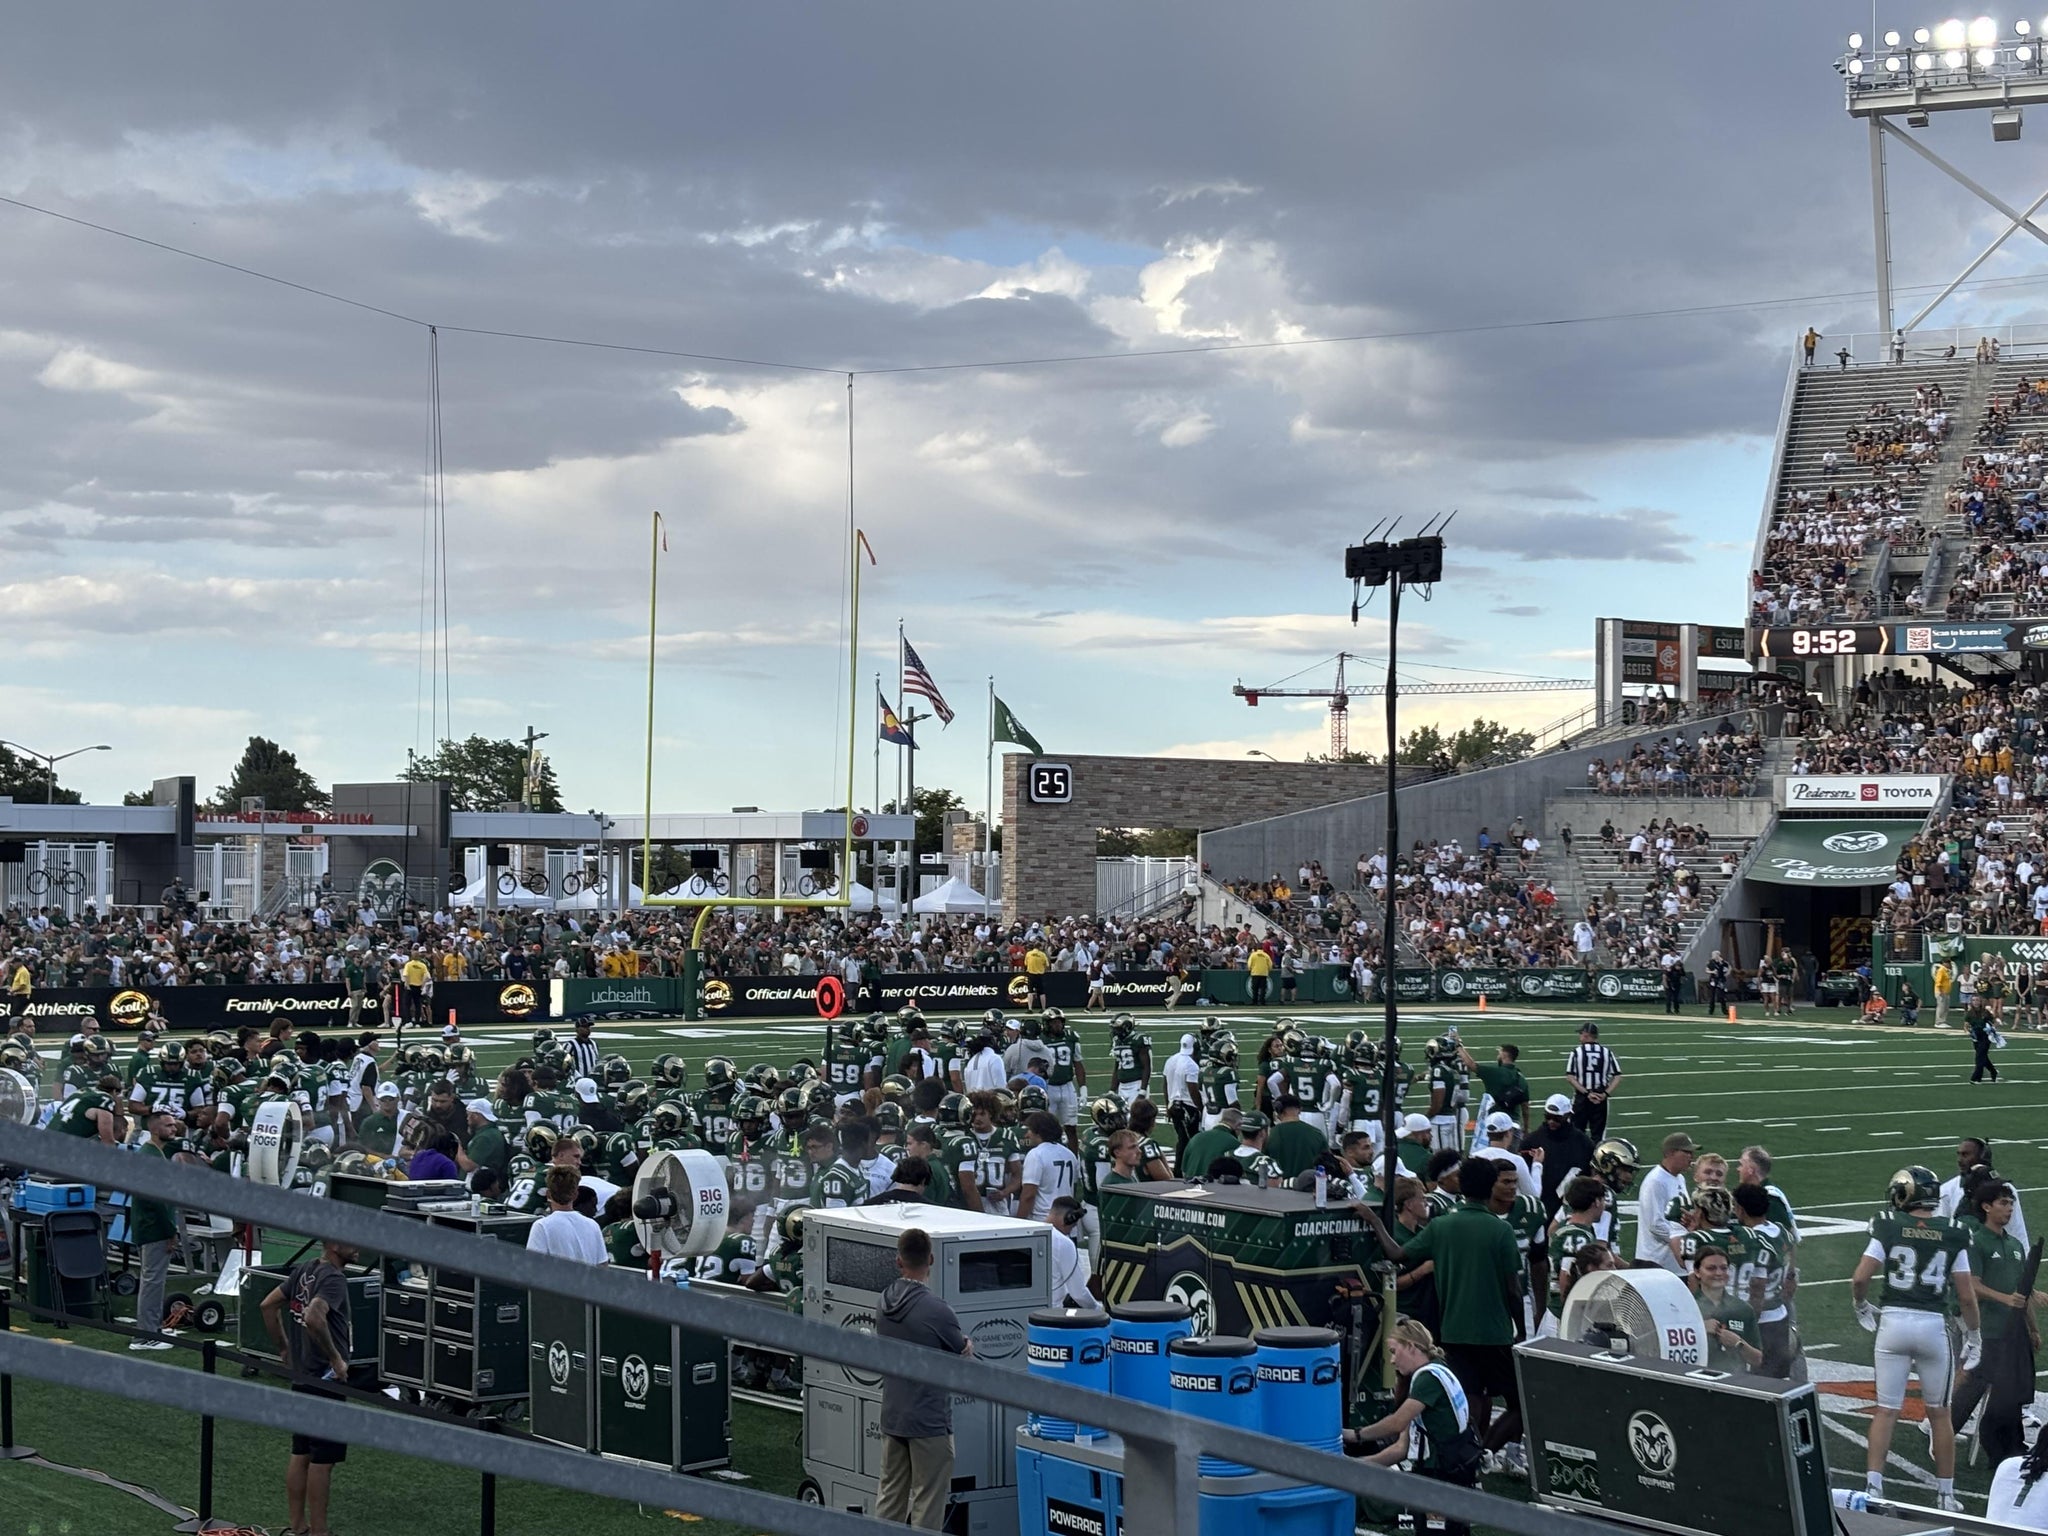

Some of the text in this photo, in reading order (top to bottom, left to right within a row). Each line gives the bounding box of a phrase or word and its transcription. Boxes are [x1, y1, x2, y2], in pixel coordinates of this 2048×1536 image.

[1715, 637, 1732, 650] CSU
[1793, 630, 1856, 654] 9:52
[1038, 772, 1065, 795] 25
[1793, 783, 1933, 800] Pedersen TOYOTA
[1771, 858, 1896, 875] Pedersen
[1821, 872, 1890, 880] TOYOTA
[696, 952, 705, 1018] RAMS
[1544, 980, 1584, 989] BELGIUM
[1552, 973, 1573, 982] NEW
[1632, 977, 1654, 985] NEW
[745, 988, 791, 1000] Official
[904, 986, 919, 997] of
[919, 985, 948, 997] CSU
[947, 984, 998, 996] Athletics
[1088, 982, 1168, 995] Fmily-Owned
[1465, 982, 1507, 990] BELGIUM
[1622, 983, 1665, 992] BELGIUM
[591, 986, 651, 1003] uchealth
[22, 1001, 96, 1016] Athletics
[226, 997, 378, 1014] Family-Owned Ato
[1053, 1045, 1072, 1066] 9
[1585, 1053, 1600, 1071] F
[1297, 1076, 1315, 1101] 5
[151, 1087, 186, 1109] 75
[523, 1095, 535, 1107] 18
[1364, 1089, 1380, 1113] 3
[59, 1098, 80, 1123] 4
[256, 1123, 278, 1135] BIG
[253, 1135, 278, 1147] FOGG
[963, 1141, 977, 1156] 81
[1054, 1160, 1074, 1189] 71
[700, 1188, 722, 1202] BIG
[824, 1180, 841, 1194] 80
[700, 1202, 723, 1216] FOGG
[1154, 1204, 1226, 1228] COACHCOMM.COM
[1902, 1227, 1944, 1241] DENNISON
[1563, 1236, 1587, 1253] 42
[1888, 1245, 1948, 1295] 34
[1728, 1319, 1745, 1330] CSU
[1001, 1332, 1023, 1341] VIDEO
[1667, 1327, 1697, 1347] BIG
[1668, 1348, 1699, 1364] FOGG
[818, 1399, 843, 1413] NETWORK
[954, 1397, 976, 1406] DATA
[1638, 1474, 1675, 1490] EQUIPMENT
[1050, 1508, 1103, 1536] POWERADE
